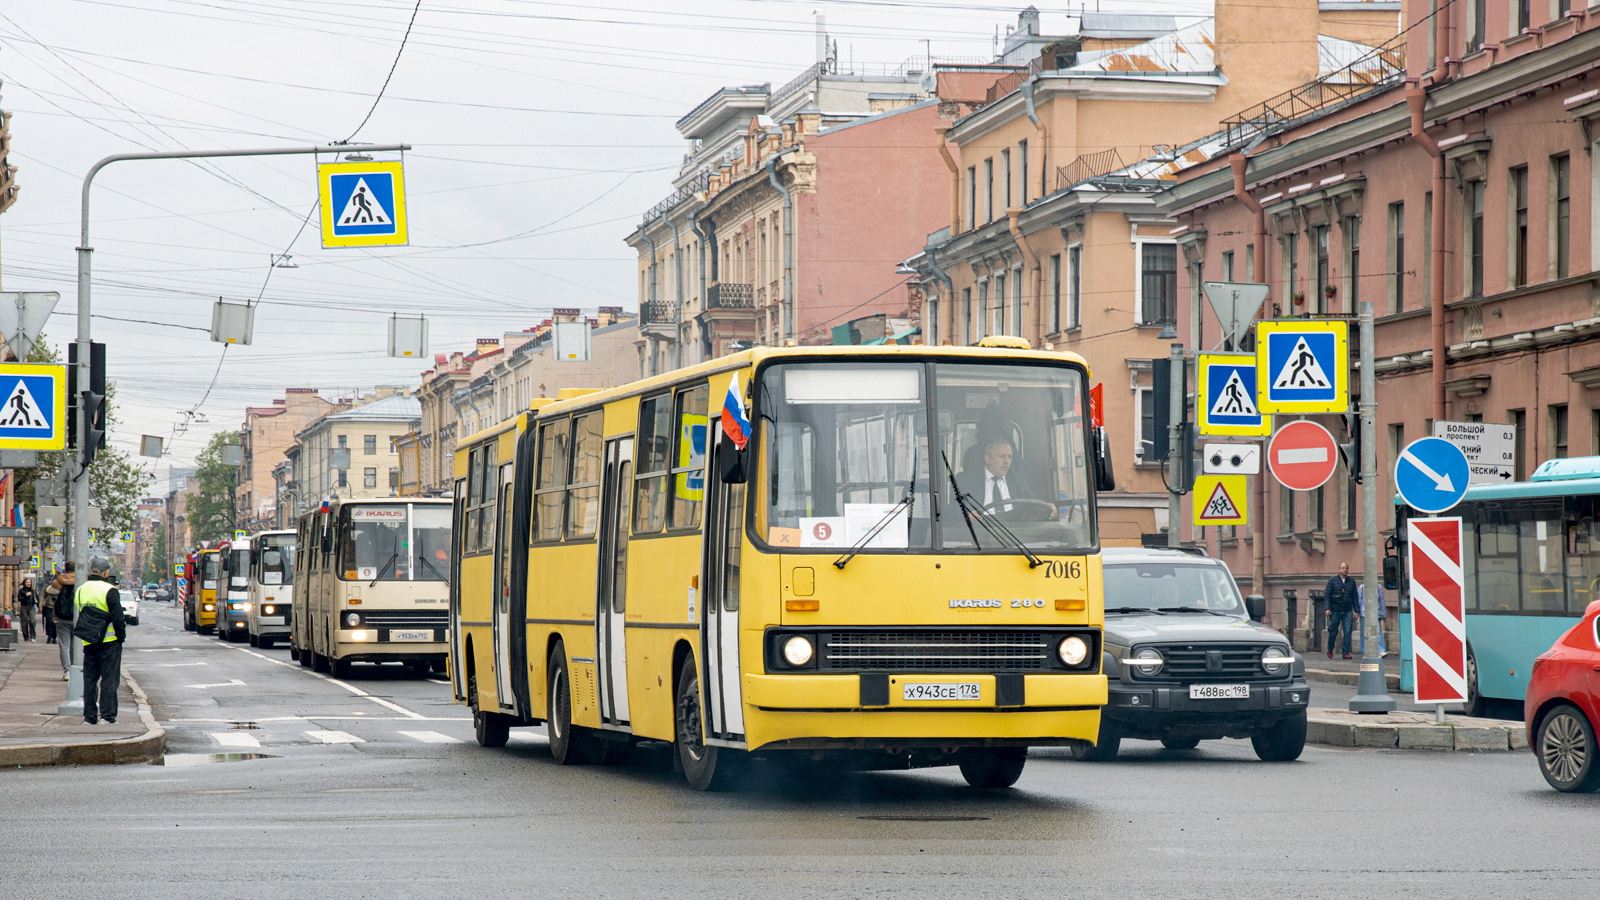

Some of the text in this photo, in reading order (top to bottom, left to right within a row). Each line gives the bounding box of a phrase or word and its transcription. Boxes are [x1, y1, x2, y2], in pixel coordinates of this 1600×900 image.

[1447, 425, 1484, 434] БОЛЬШОЙ
[1462, 445, 1481, 454] ДНИЙ
[1470, 466, 1498, 475] ЧЕСКИЙ
[818, 526, 826, 538] 5
[1042, 560, 1080, 579] 7016
[949, 599, 1045, 608] IKARUS 280
[959, 685, 977, 694] 178
